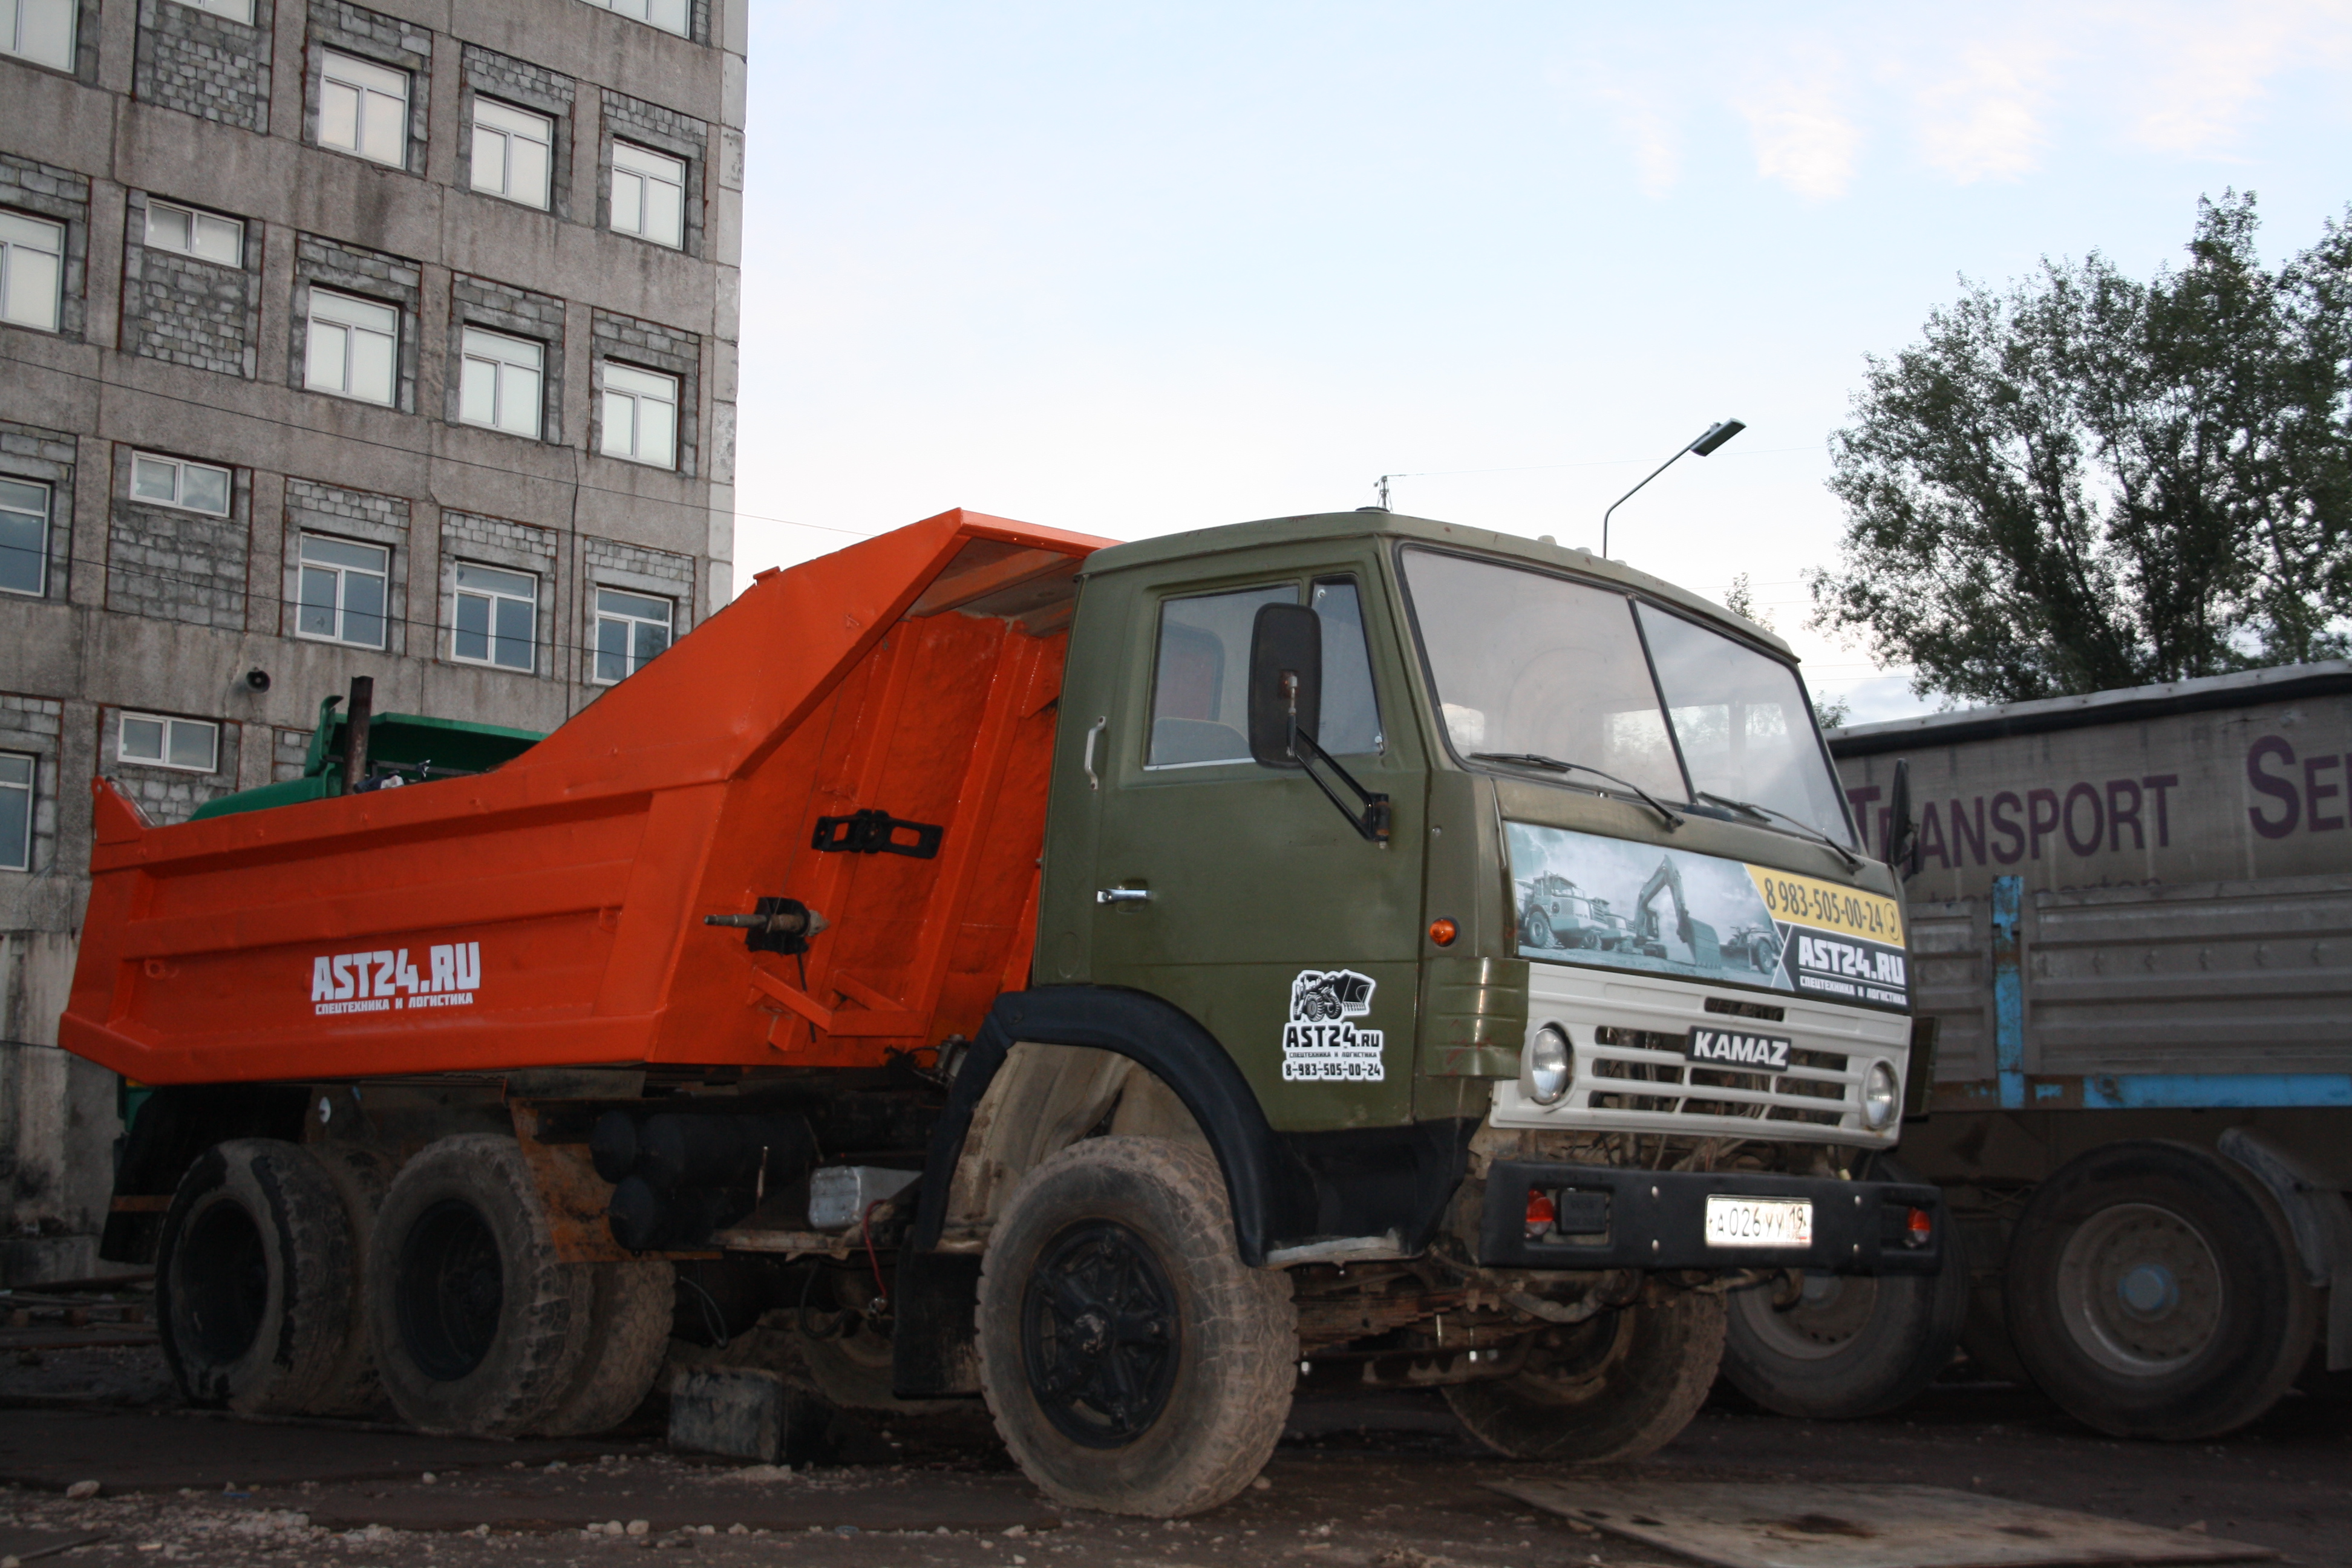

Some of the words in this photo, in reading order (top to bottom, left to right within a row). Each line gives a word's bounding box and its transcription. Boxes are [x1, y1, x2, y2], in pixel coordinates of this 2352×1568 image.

[1765, 878, 1776, 910] 8
[1778, 881, 1884, 934] 983-505-00-24
[311, 941, 480, 1001] AST24.RU
[1798, 935, 1905, 985] AST24.RU
[1800, 975, 1855, 996] СПЕЦТЕХНИКА
[316, 999, 390, 1015] СПЕЦТЕХНИКА
[395, 998, 403, 1010] И
[408, 992, 474, 1008] ЛОГИСТИКА
[1286, 1025, 1380, 1047] AST24.RU
[1694, 1031, 1789, 1067] KAMAZ
[1285, 1063, 1380, 1076] 8-983-505-00-24
[1789, 1206, 1803, 1229] 19
